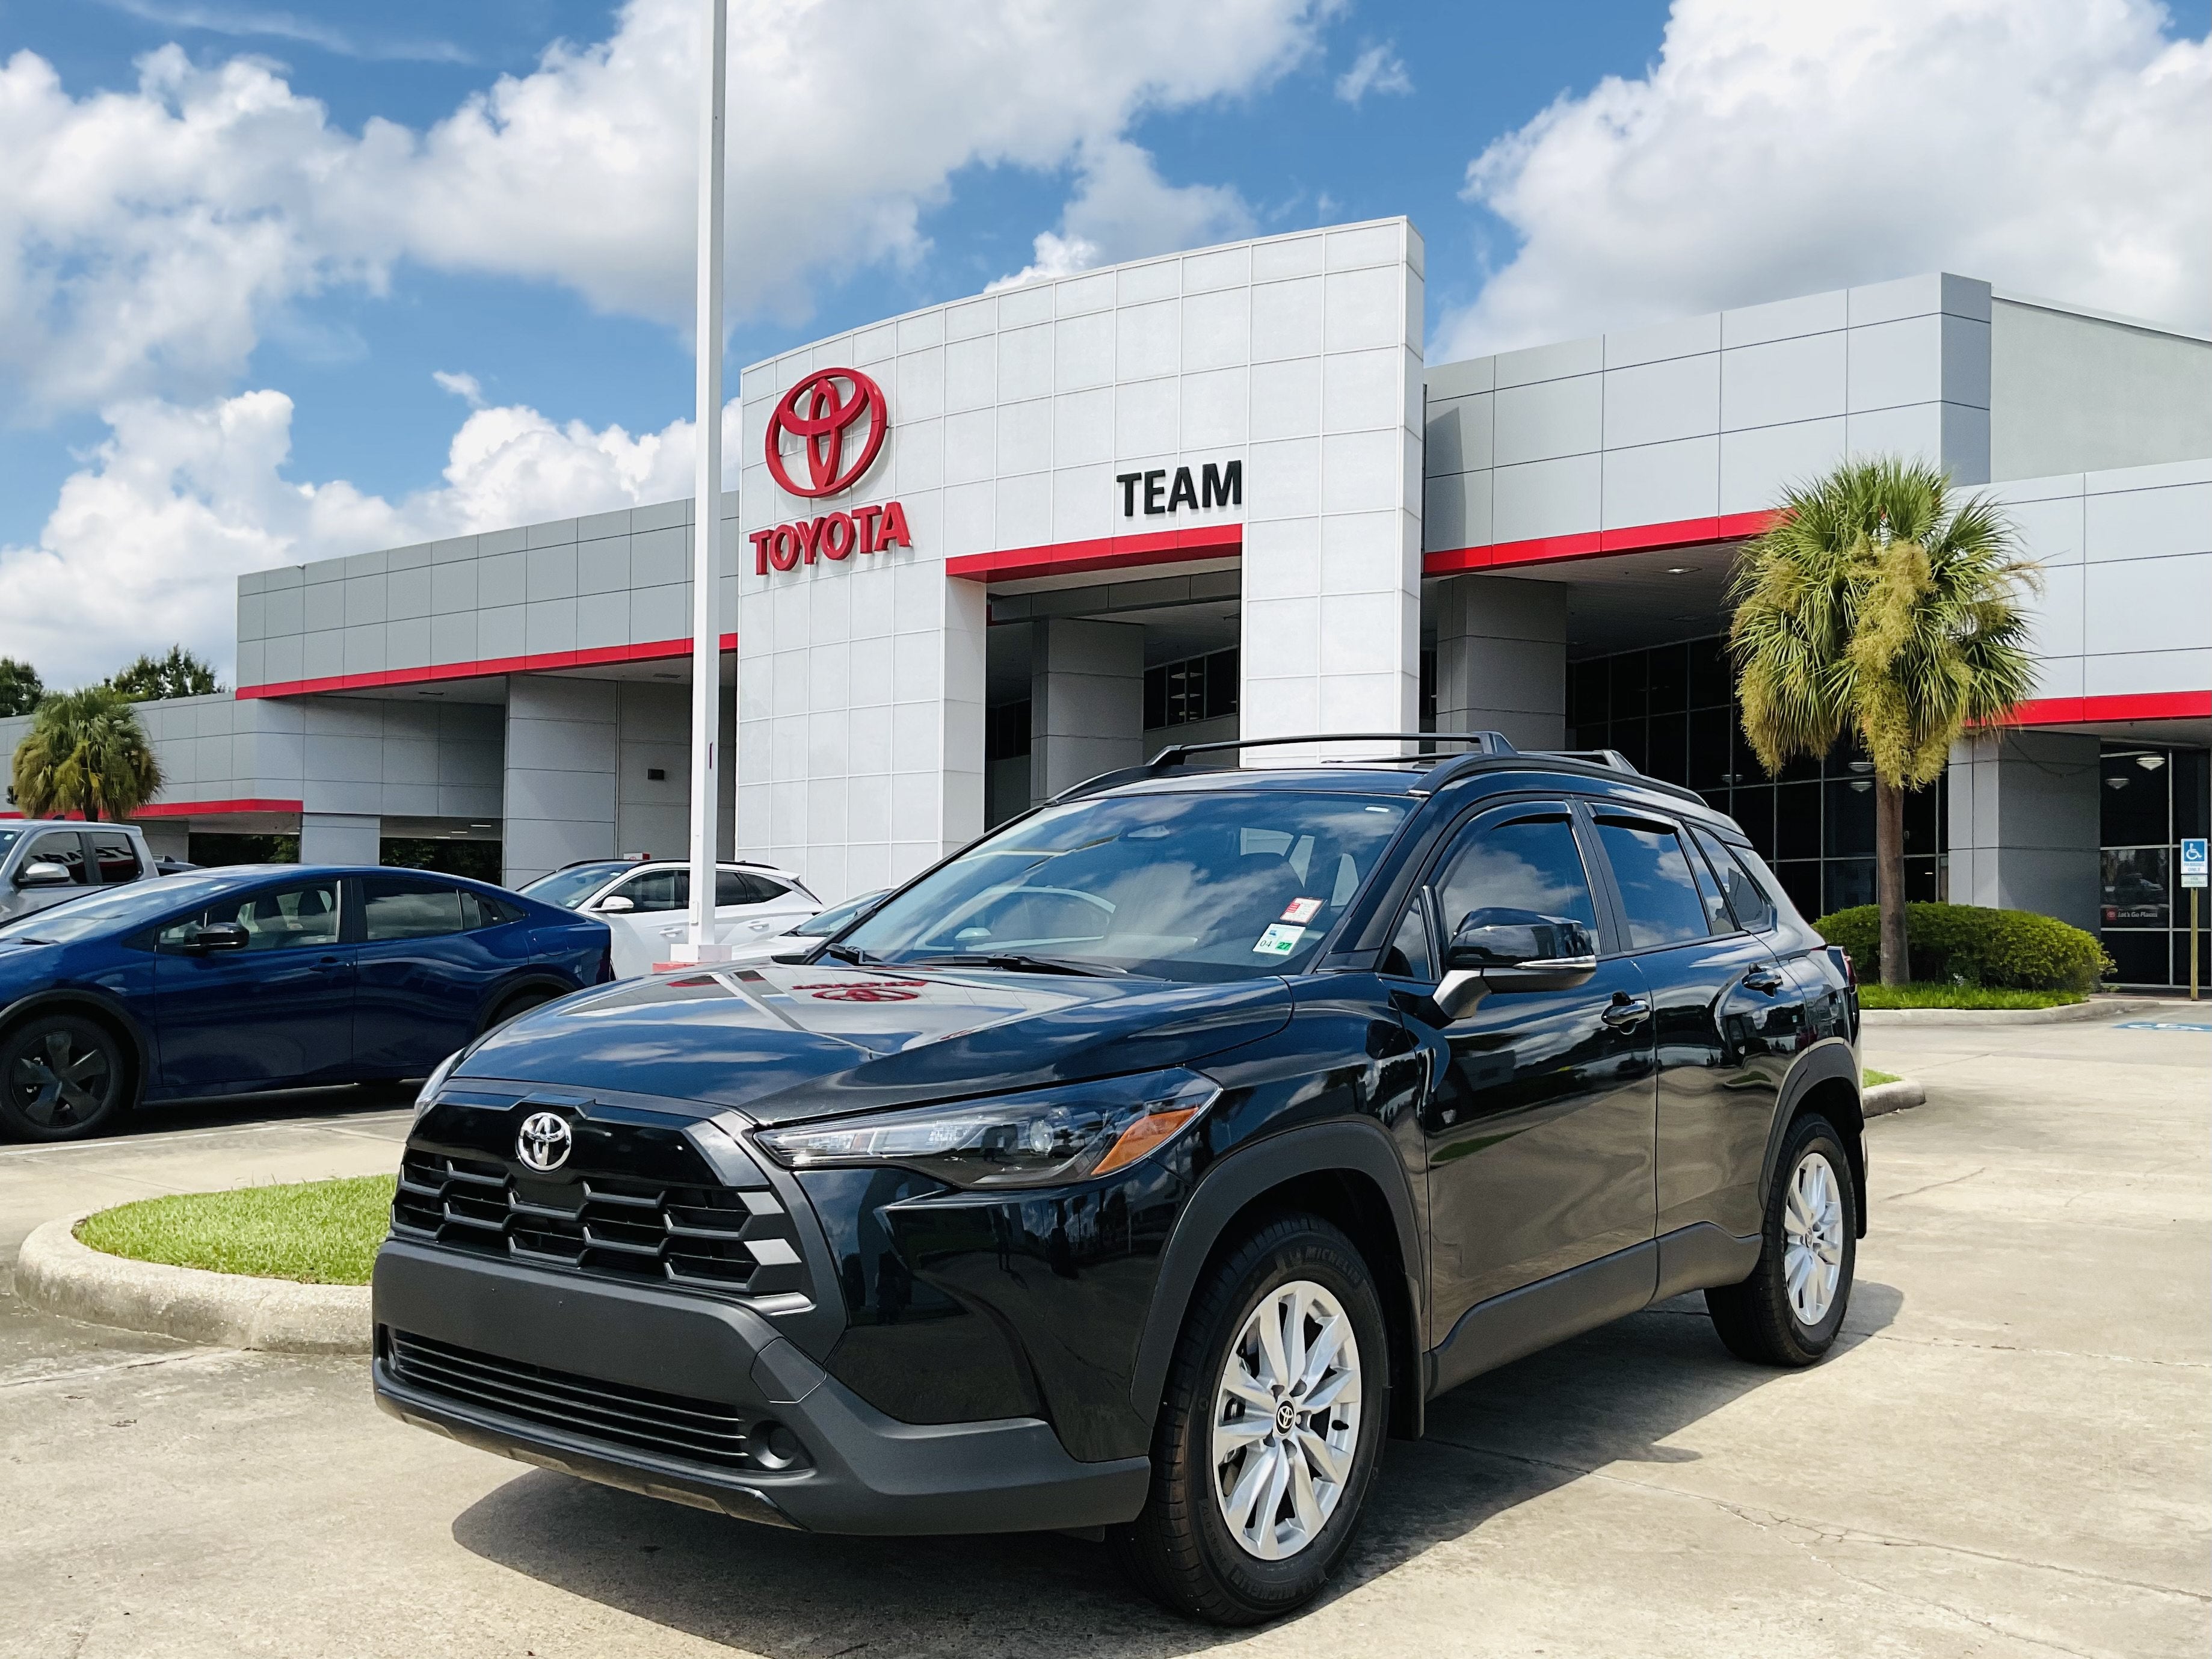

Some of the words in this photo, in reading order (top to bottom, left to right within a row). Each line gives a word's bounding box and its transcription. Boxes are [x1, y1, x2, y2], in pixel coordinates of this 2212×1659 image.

[1117, 460, 1242, 517] TEAM
[750, 502, 913, 576] TOYOTA
[1260, 939, 1272, 948] 04
[1305, 1246, 1362, 1284] MICHELIN
